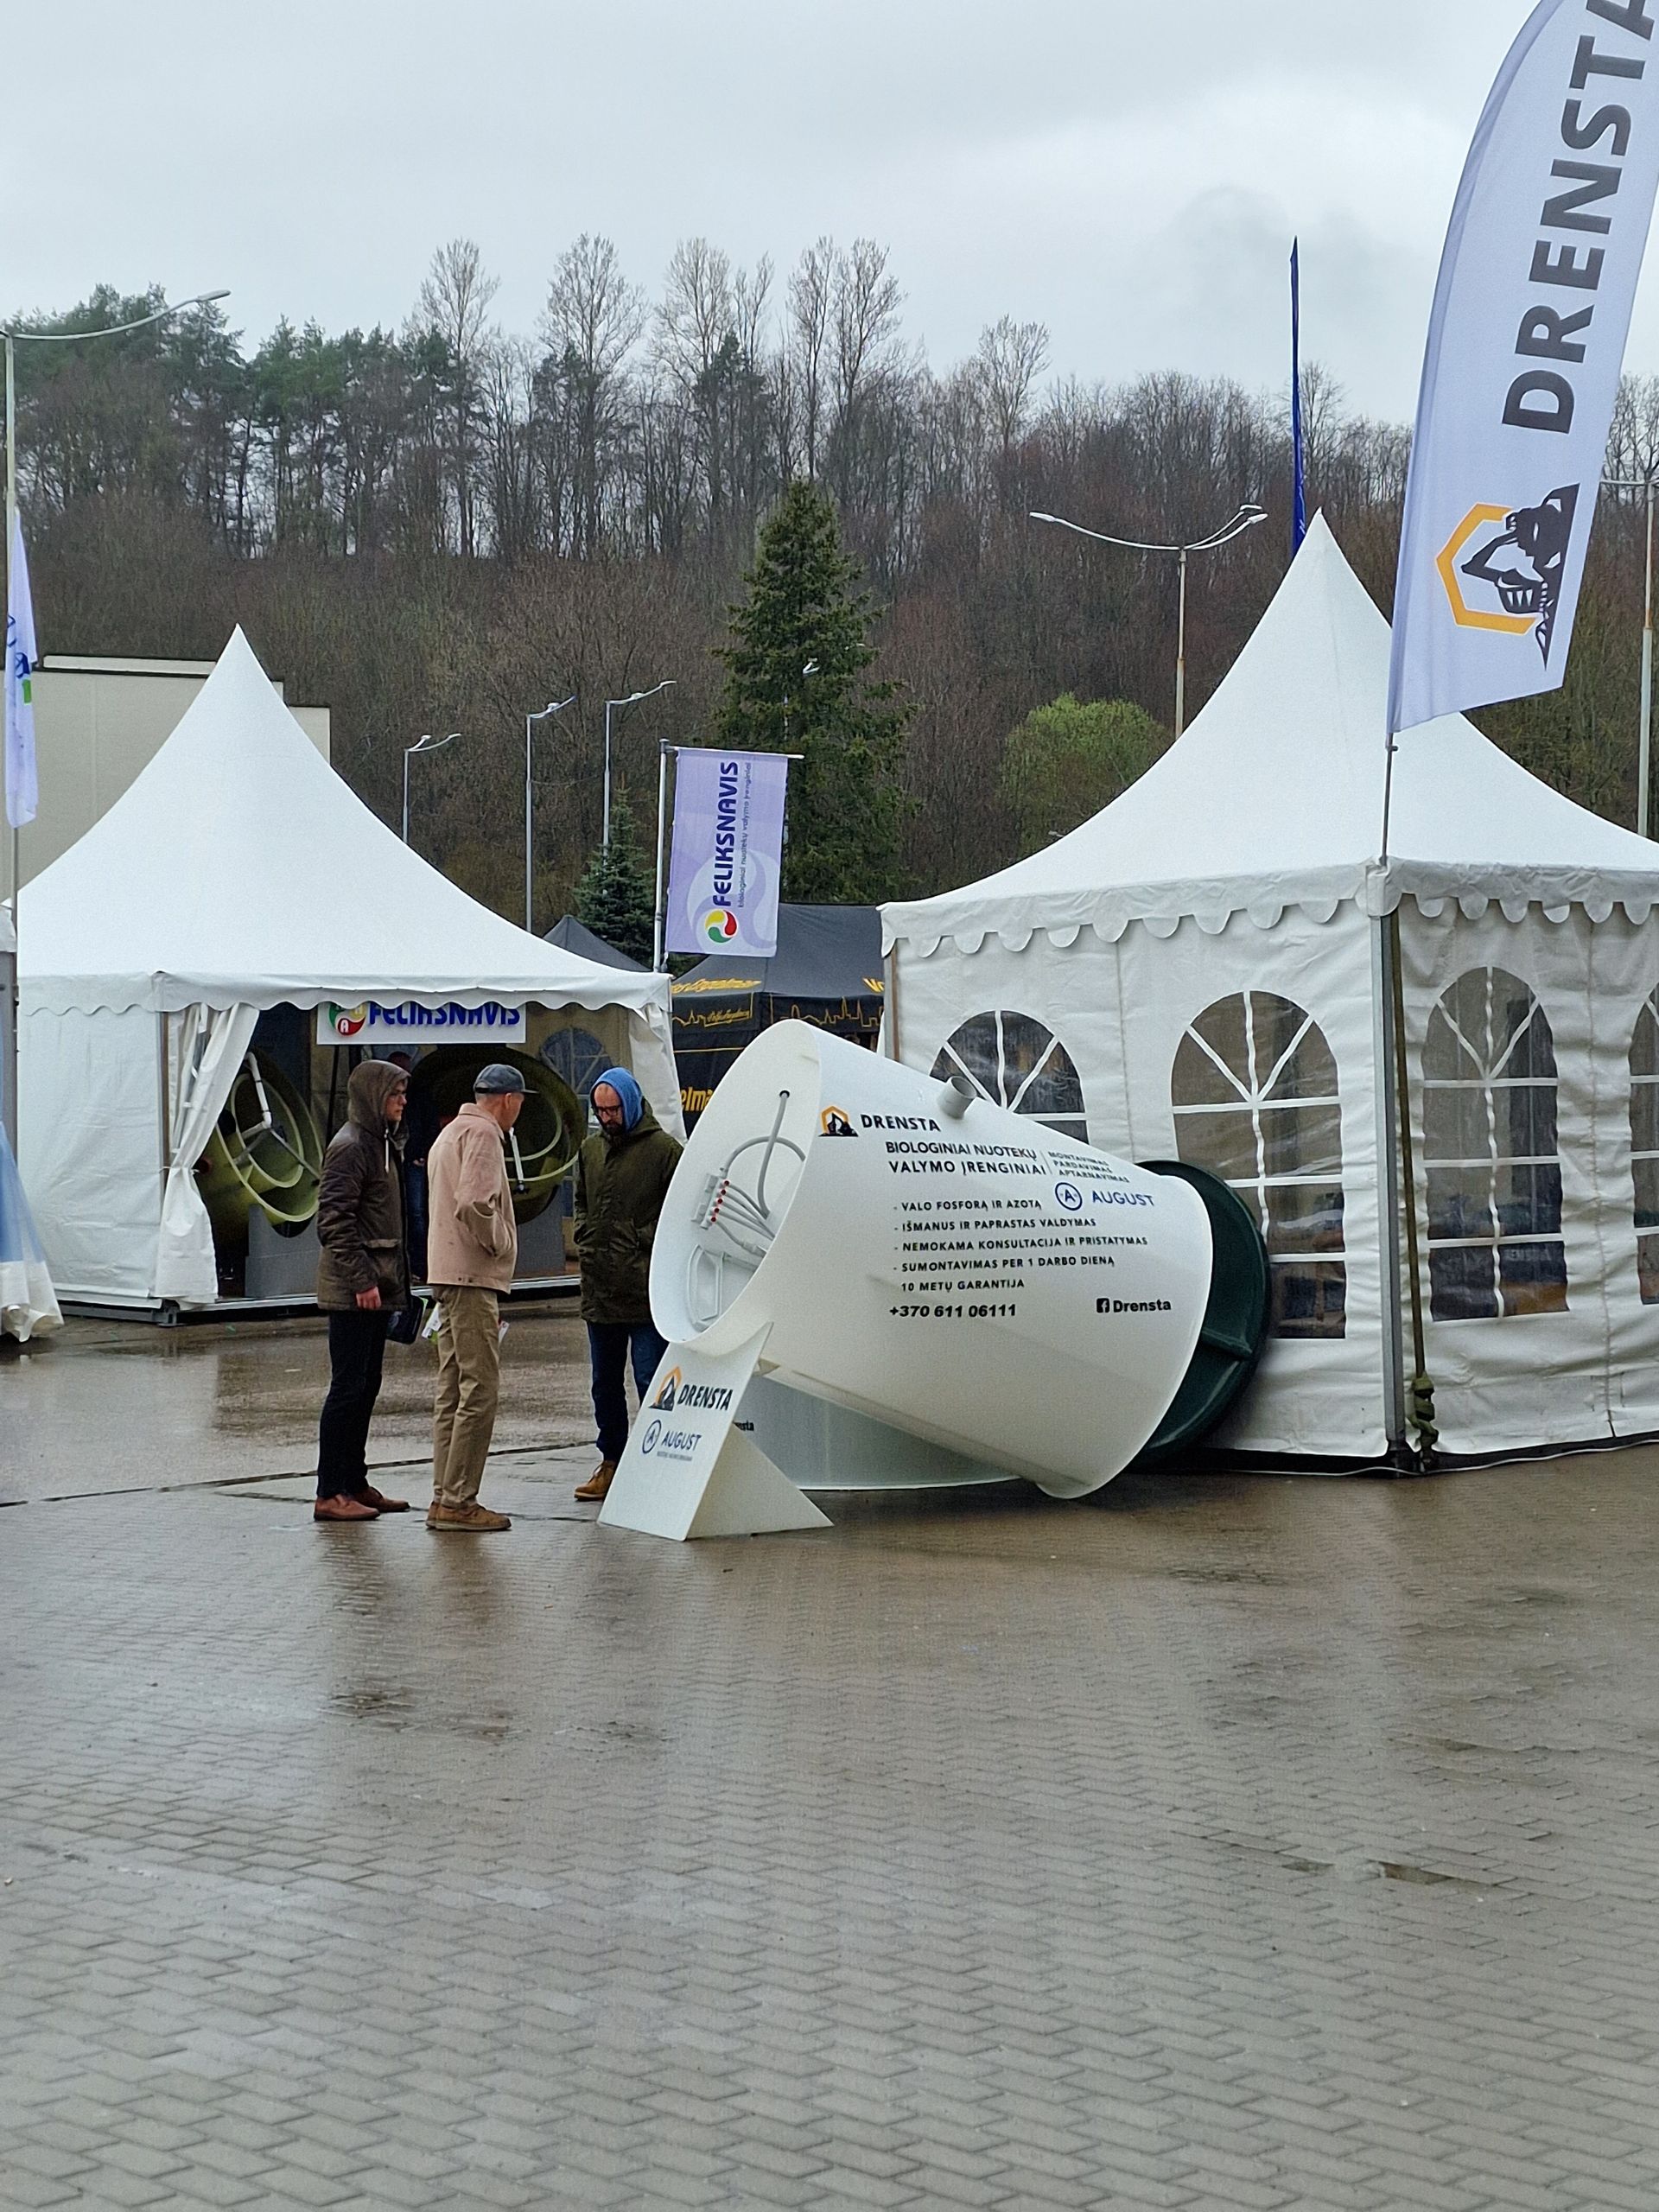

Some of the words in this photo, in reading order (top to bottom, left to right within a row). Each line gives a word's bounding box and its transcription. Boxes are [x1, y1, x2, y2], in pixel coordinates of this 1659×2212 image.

[713, 762, 738, 906] FELIKSNAVIS
[861, 1114, 941, 1132] DRENSTA
[886, 1141, 970, 1154] BIOLOGINIAI
[973, 1144, 1038, 1161] NUOTEKŲ
[1048, 1151, 1109, 1166] MONTAVIMAS
[888, 1160, 956, 1173] VALYMO
[961, 1161, 1046, 1175] ĮRENGINIAI
[1053, 1160, 1113, 1173] PARDAVIMAS
[1058, 1170, 1130, 1183] APTARNAVIMAS
[901, 1202, 932, 1211] VALO
[937, 1200, 988, 1211] FOSFORĄ
[992, 1200, 1002, 1209] IR
[1007, 1199, 1042, 1210] AZOTĄ
[1091, 1191, 1155, 1207] AUGUST
[902, 1220, 955, 1232] IŠMANUS
[960, 1221, 970, 1230] IR
[975, 1219, 1036, 1229] PAPRASTAS
[1039, 1218, 1096, 1227] VALDYMAS
[903, 1241, 974, 1251] NEMOKAMA
[978, 1238, 1061, 1249] KONSULTACIJA
[1079, 1236, 1147, 1245] PRISTATYMAS
[901, 1259, 998, 1272] SUMONTAVIMAS
[1002, 1258, 1023, 1268] PER
[1028, 1258, 1033, 1267] 1
[1038, 1256, 1077, 1267] DARBO
[1081, 1256, 1115, 1268] DIENĄ
[901, 1282, 915, 1292] 10
[919, 1281, 953, 1293] METŲ
[957, 1279, 1025, 1290] GARANTIJA
[889, 1306, 930, 1317] +370
[934, 1305, 963, 1318] 611
[968, 1304, 1016, 1317] 06111
[1113, 1299, 1172, 1313] Drensta
[677, 1384, 734, 1410] DRENSTA
[661, 1430, 702, 1452] AUGUST
